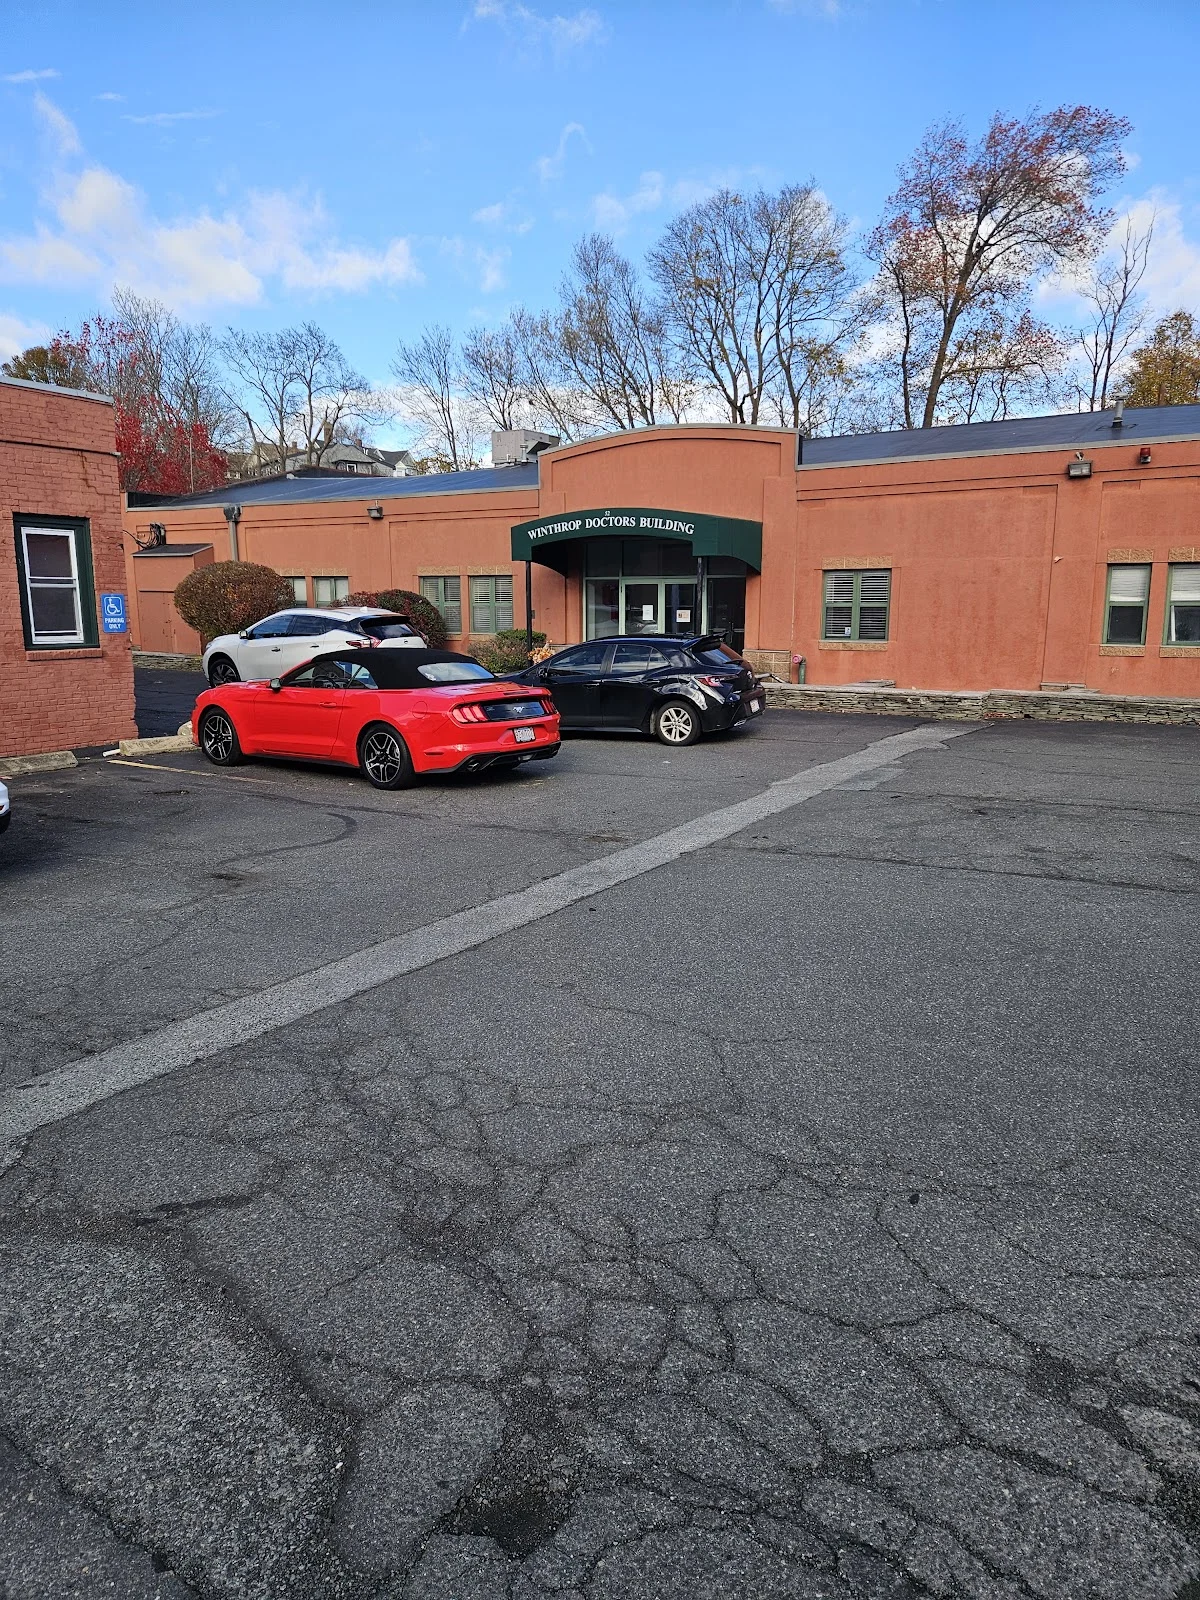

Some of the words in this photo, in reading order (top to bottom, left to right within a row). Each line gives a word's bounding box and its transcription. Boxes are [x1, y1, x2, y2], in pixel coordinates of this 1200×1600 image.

[527, 519, 582, 540] WINTHROP
[585, 516, 636, 529] DOCTORS
[639, 516, 695, 535] BUILDING
